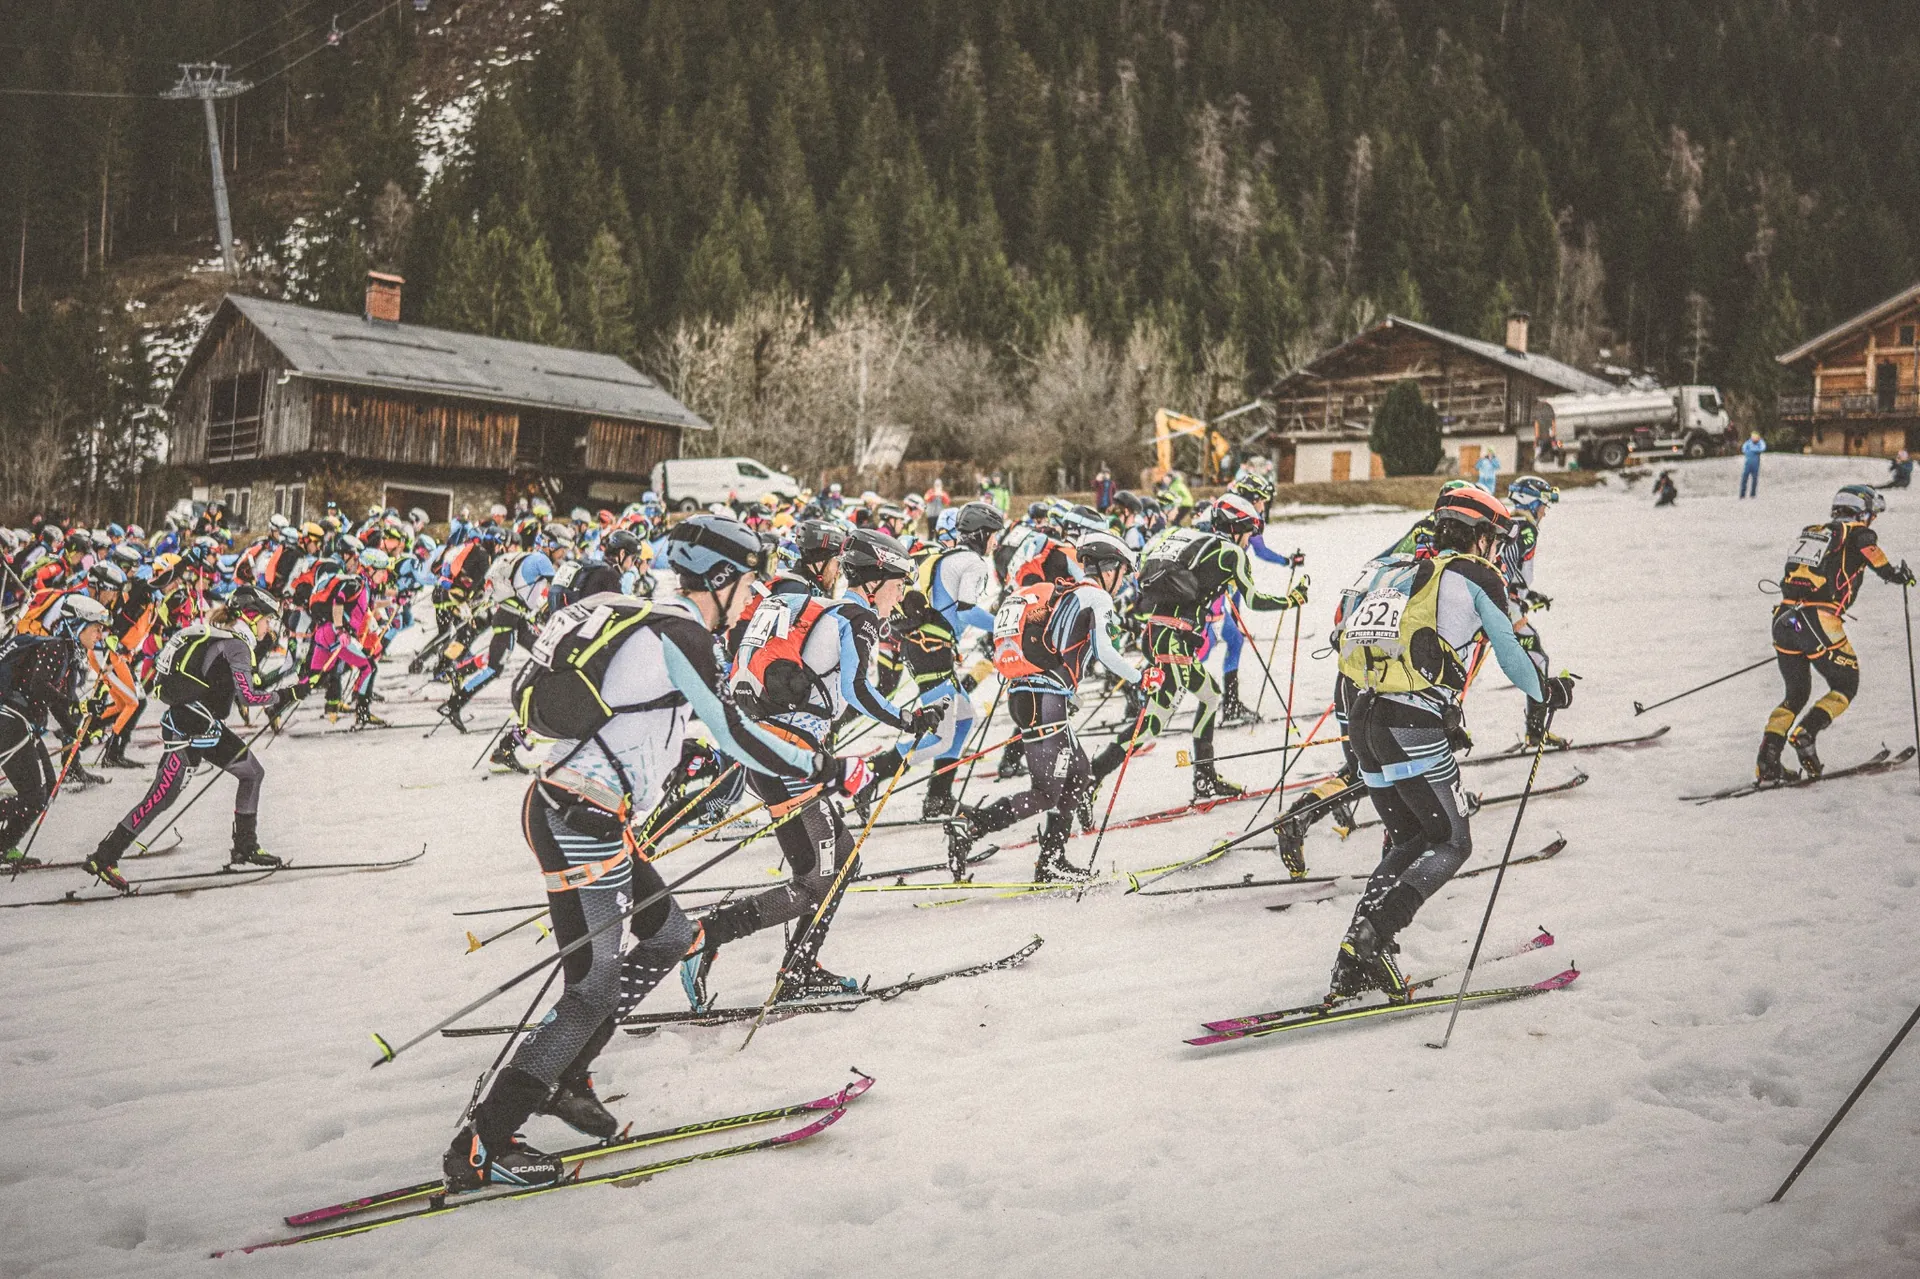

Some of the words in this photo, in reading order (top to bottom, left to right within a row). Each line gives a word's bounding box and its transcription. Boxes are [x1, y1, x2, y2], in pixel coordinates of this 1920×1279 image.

[997, 608, 1010, 629] 22
[1353, 601, 1390, 627] 152
[1391, 610, 1399, 628] B
[760, 620, 772, 637] A
[131, 752, 182, 830] DYNAFIT
[511, 1164, 556, 1174] SCARPA
